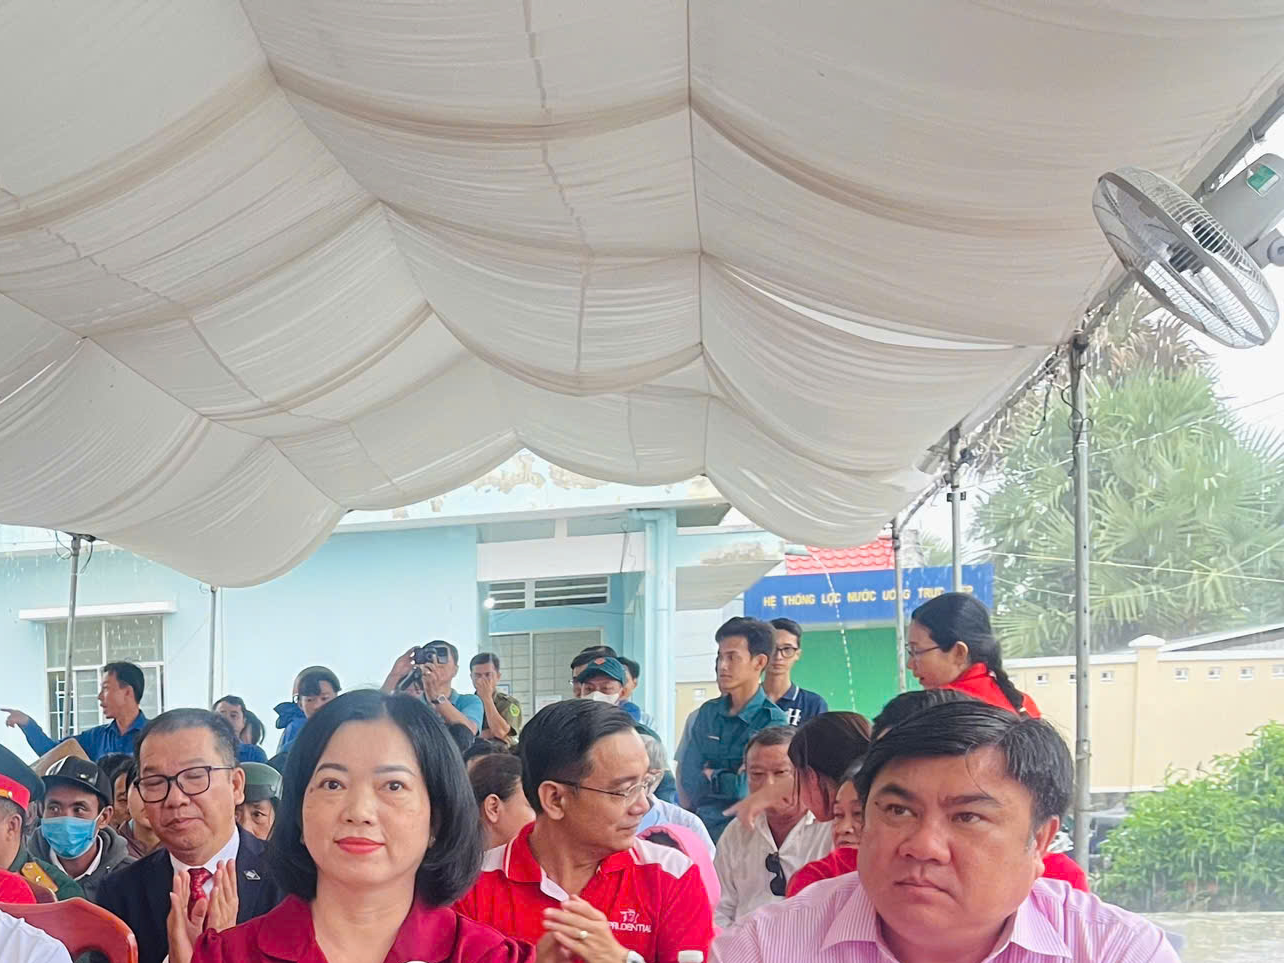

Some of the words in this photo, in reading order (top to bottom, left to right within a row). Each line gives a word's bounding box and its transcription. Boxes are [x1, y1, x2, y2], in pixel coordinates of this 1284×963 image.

[763, 594, 777, 610] HỆ
[782, 592, 816, 607] THỐNG
[821, 592, 841, 607] LỌC
[847, 588, 876, 603] NƯỚC
[882, 586, 911, 601] UỐG
